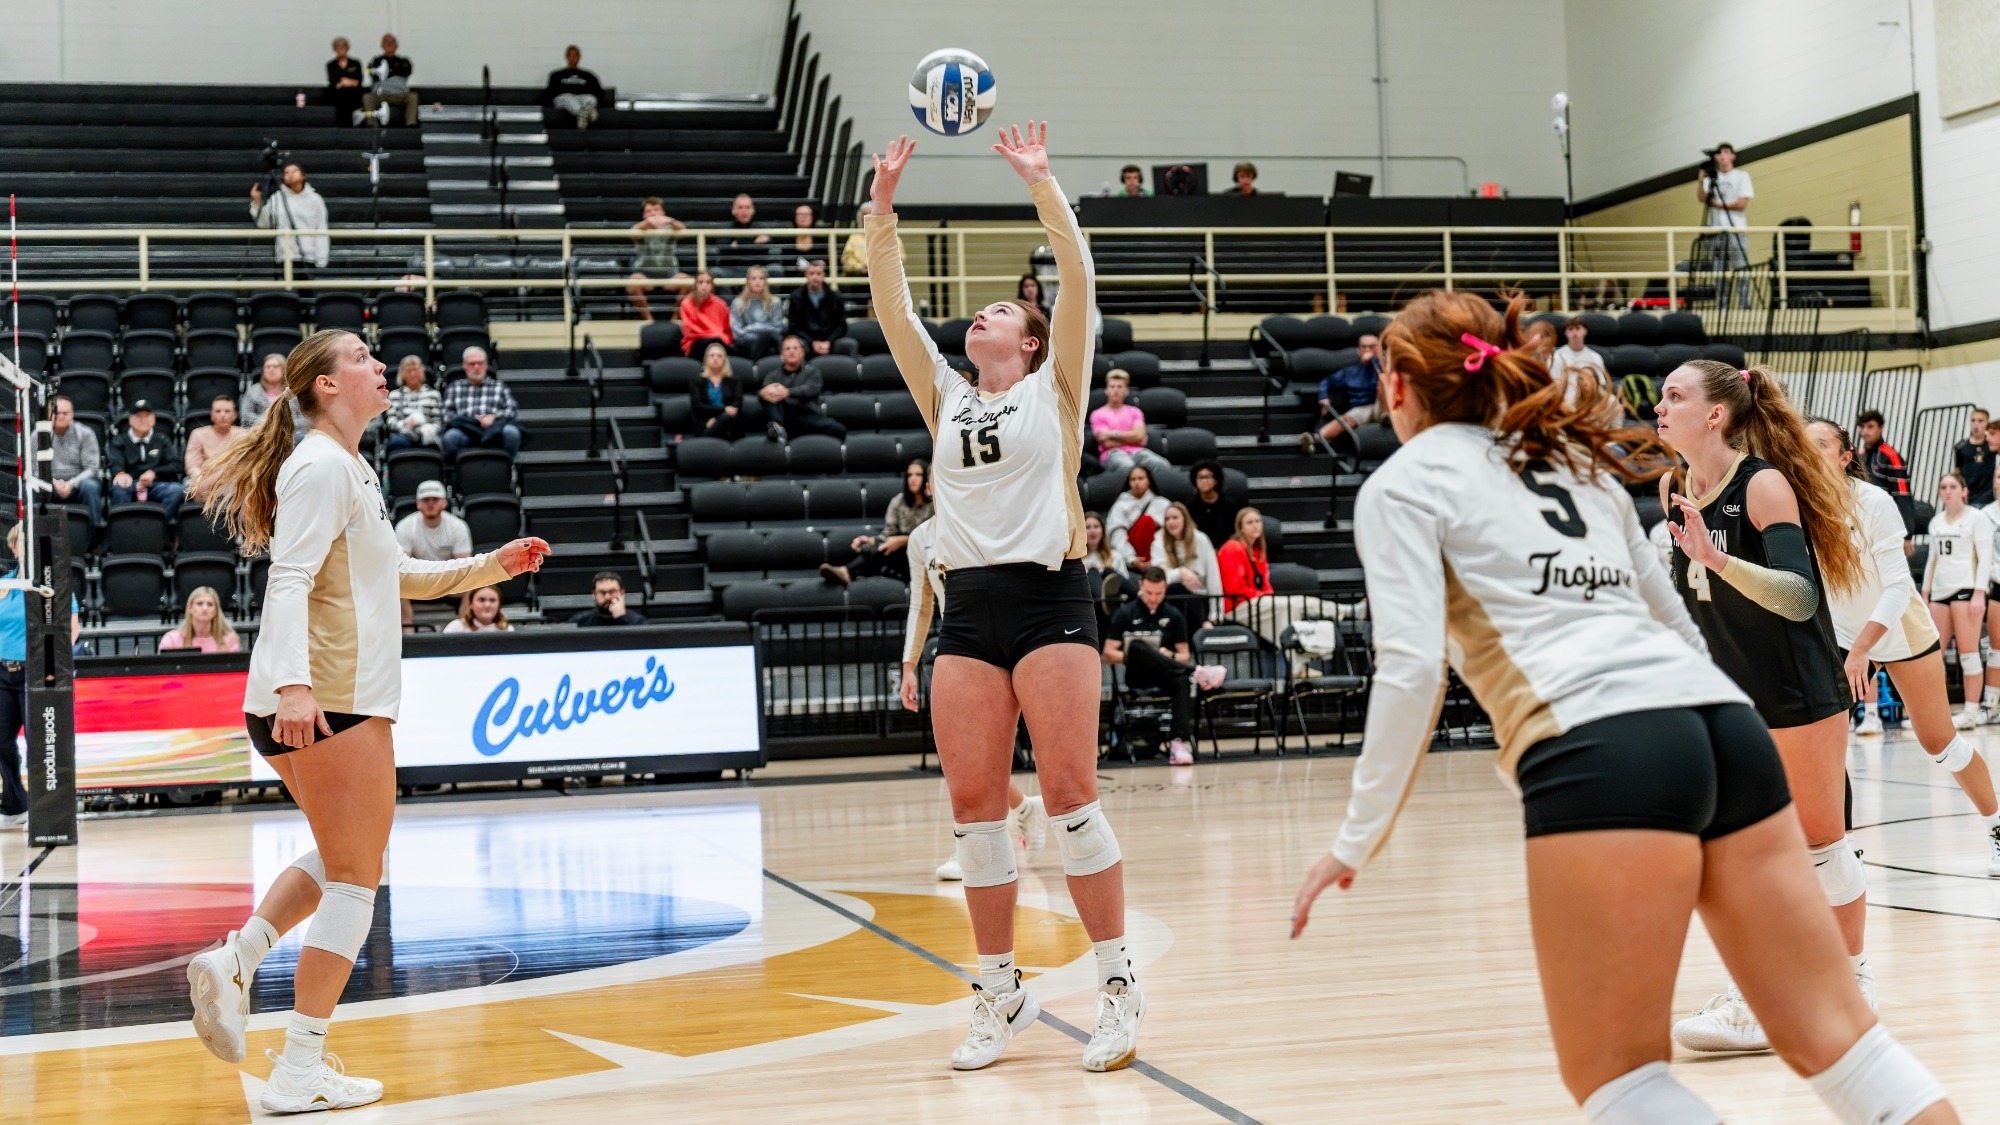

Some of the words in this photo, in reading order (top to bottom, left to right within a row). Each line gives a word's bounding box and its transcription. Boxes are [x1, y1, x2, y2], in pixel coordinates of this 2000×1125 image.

[963, 76, 976, 124] molten
[960, 421, 1002, 468] 15
[1518, 459, 1587, 538] 5
[1939, 540, 1952, 555] 19
[1686, 559, 1712, 602] 4
[42, 706, 57, 744] sports
[472, 655, 675, 757] Culver's
[43, 744, 58, 791] imports
